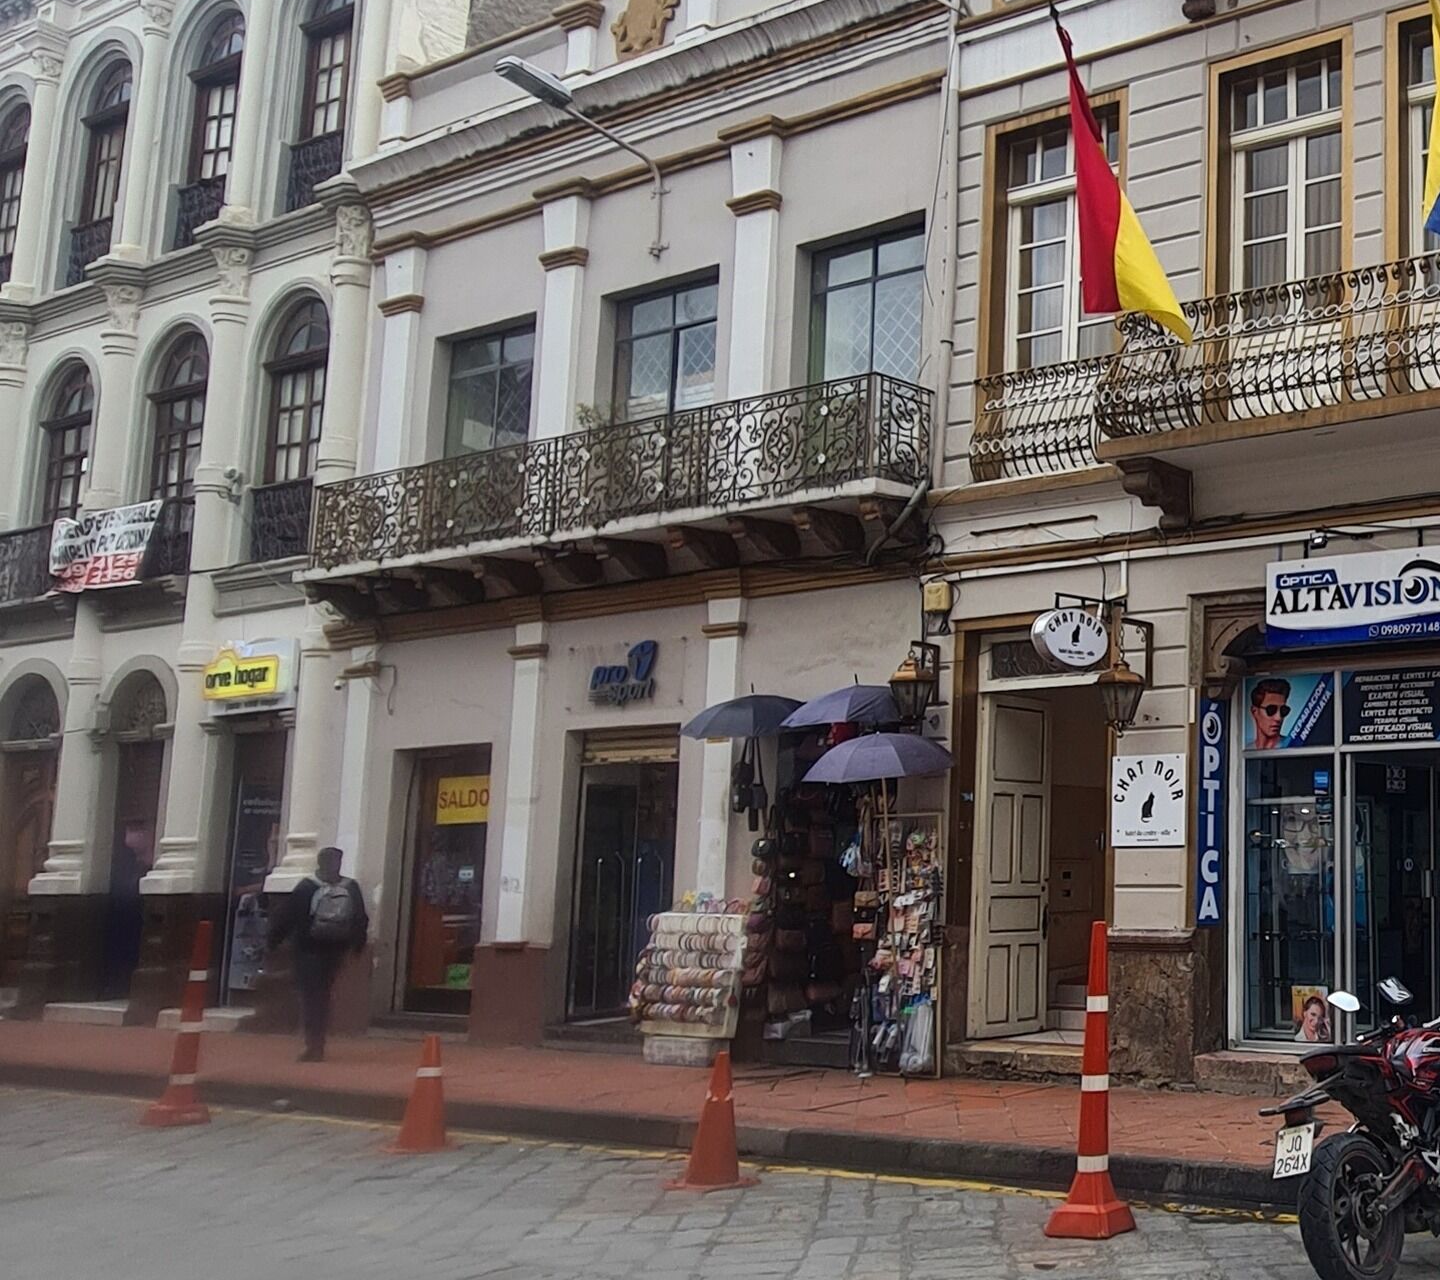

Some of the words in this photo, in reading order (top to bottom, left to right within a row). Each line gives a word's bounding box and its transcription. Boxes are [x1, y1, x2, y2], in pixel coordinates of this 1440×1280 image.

[1279, 573, 1334, 587] ÓPTICA
[1048, 611, 1074, 632] CHAT
[1080, 613, 1103, 637] NOIR
[1381, 621, 1440, 636] 0980972148
[234, 665, 269, 688] hogar
[589, 665, 628, 690] pro
[608, 678, 656, 706] sport
[1290, 681, 1326, 739] REPARACION
[1398, 706, 1433, 715] CONTACTO
[1360, 724, 1406, 734] CERTIFICADO
[1407, 722, 1433, 731] VISUAL
[1113, 760, 1144, 802] CHAT
[1154, 760, 1183, 800] NOIR
[439, 789, 490, 809] SALDO
[1276, 1152, 1308, 1175] 264X
